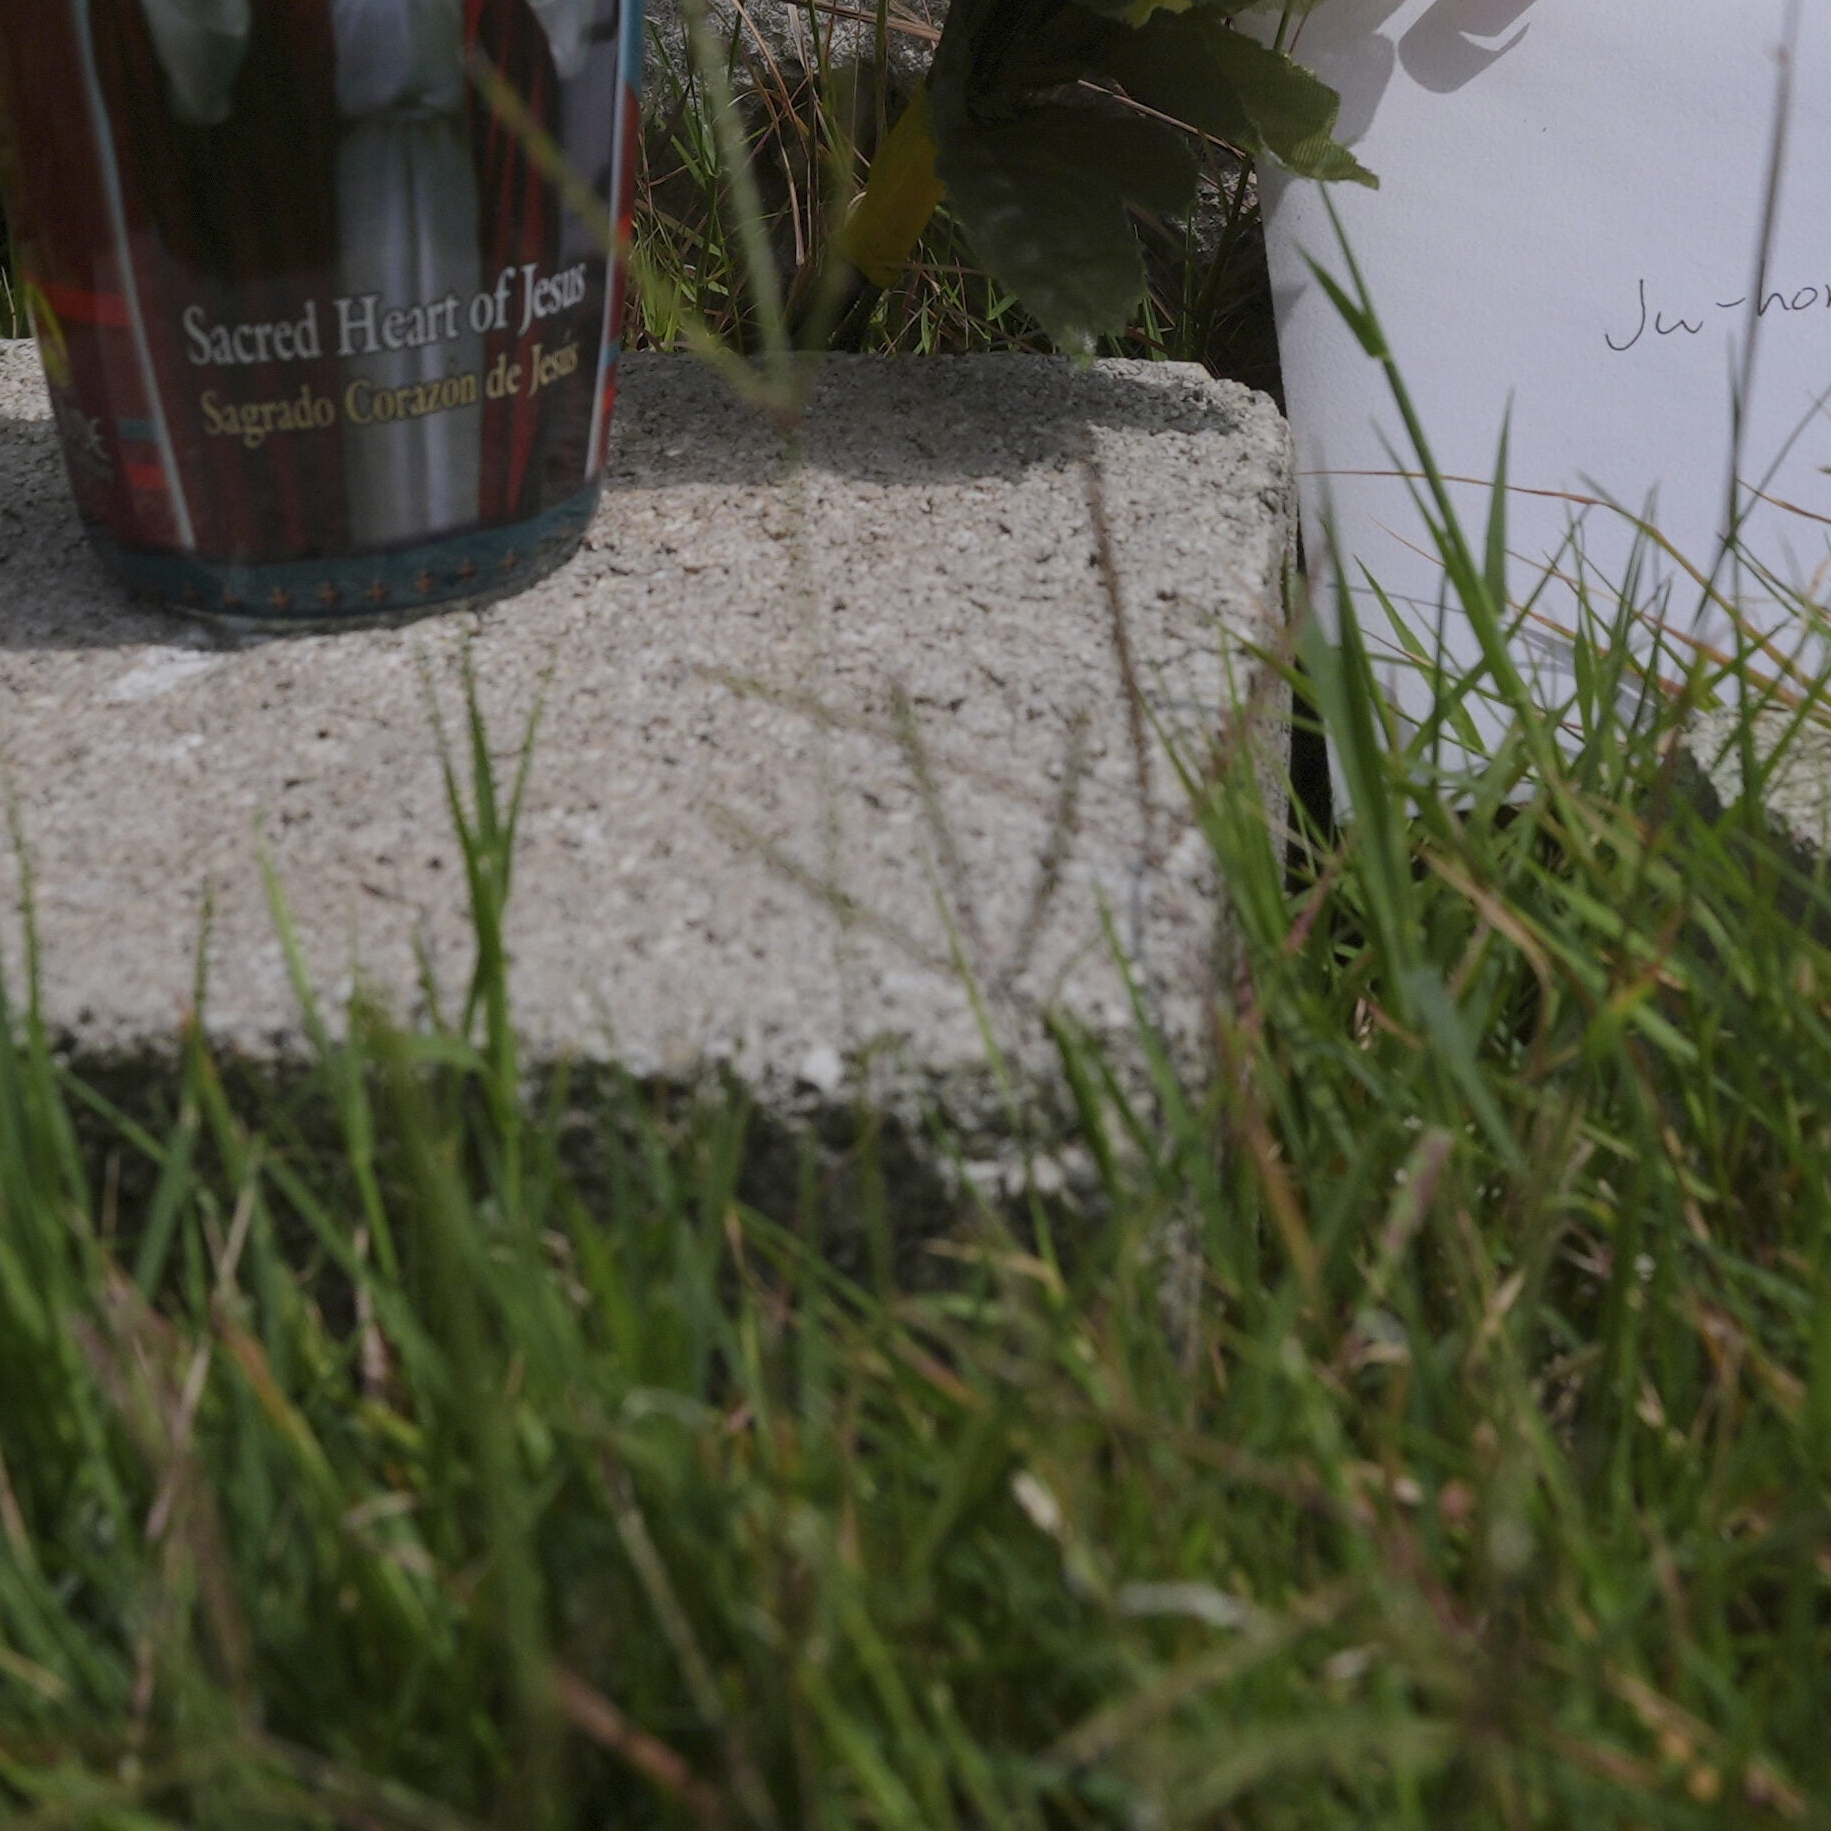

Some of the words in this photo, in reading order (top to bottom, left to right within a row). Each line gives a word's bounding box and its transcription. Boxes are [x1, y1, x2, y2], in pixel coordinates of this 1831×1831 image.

[183, 300, 321, 366] Sacred
[334, 293, 459, 356] Heart
[469, 267, 515, 334] of
[517, 263, 587, 336] Jesus
[200, 384, 336, 450] Sagrado
[486, 352, 522, 401] de
